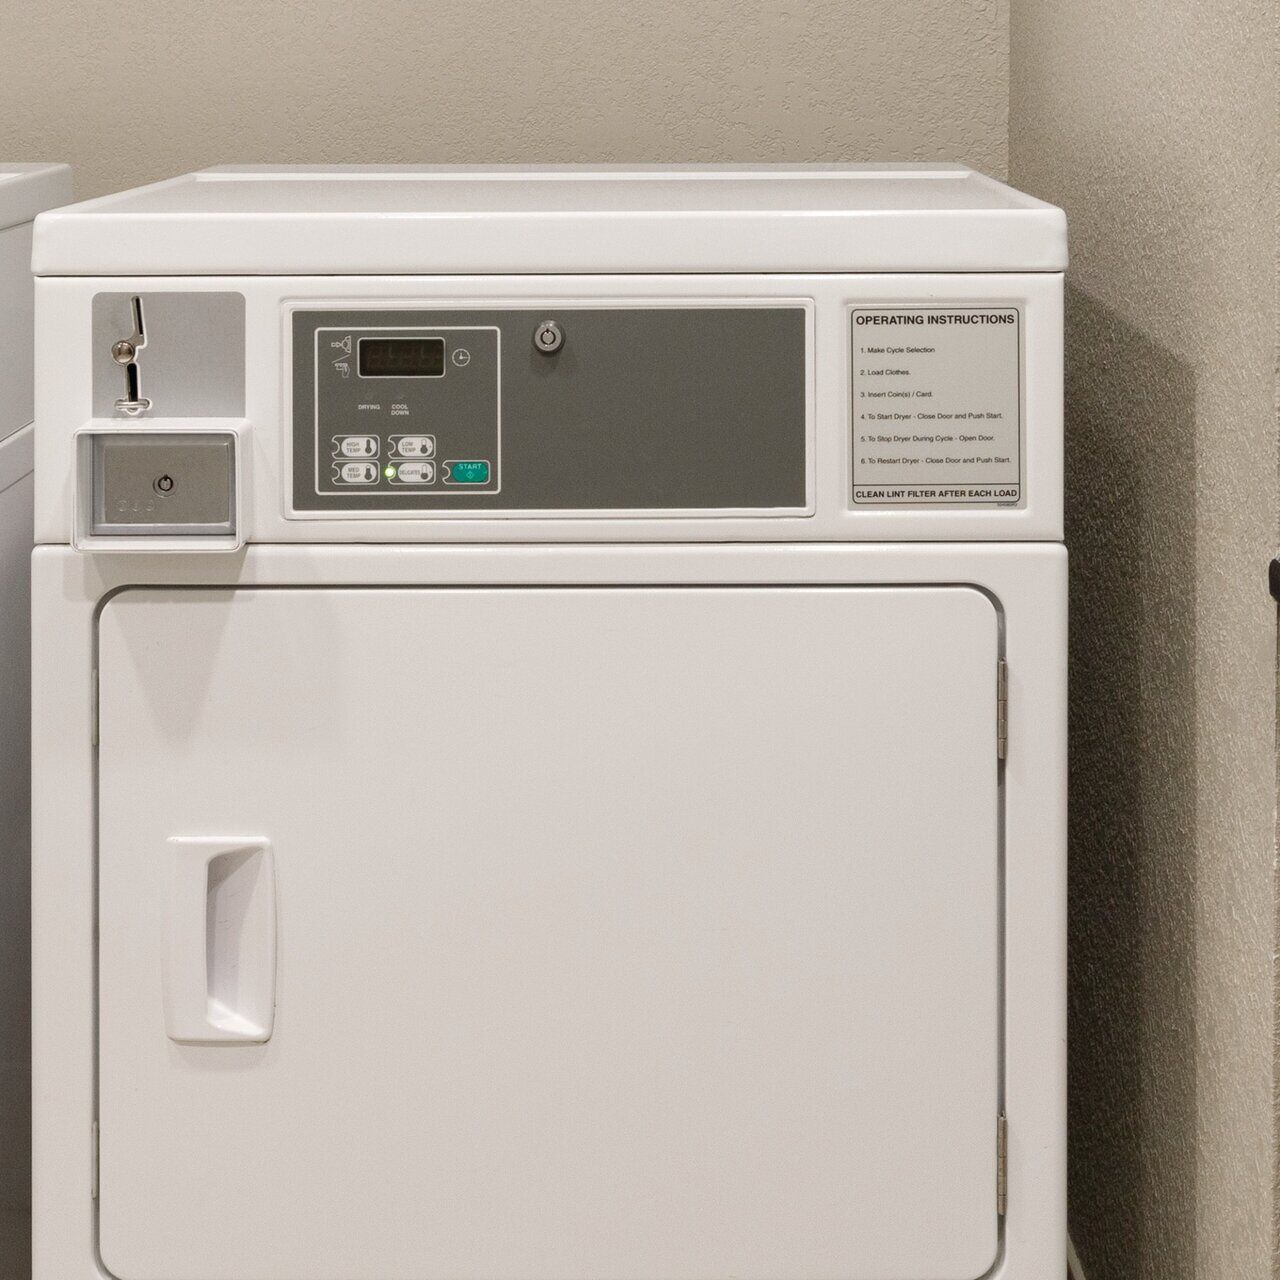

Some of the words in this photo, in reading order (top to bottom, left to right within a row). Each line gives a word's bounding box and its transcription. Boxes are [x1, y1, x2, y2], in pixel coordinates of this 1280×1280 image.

[856, 315, 924, 325] OPERATING
[927, 314, 1015, 325] INSTRUCTIONS
[894, 413, 912, 421] Dryer
[886, 490, 905, 498] LINT
[907, 490, 936, 498] FILTER
[938, 490, 966, 498] AFTER
[968, 490, 991, 498] EACH
[994, 489, 1017, 497] LOAD
